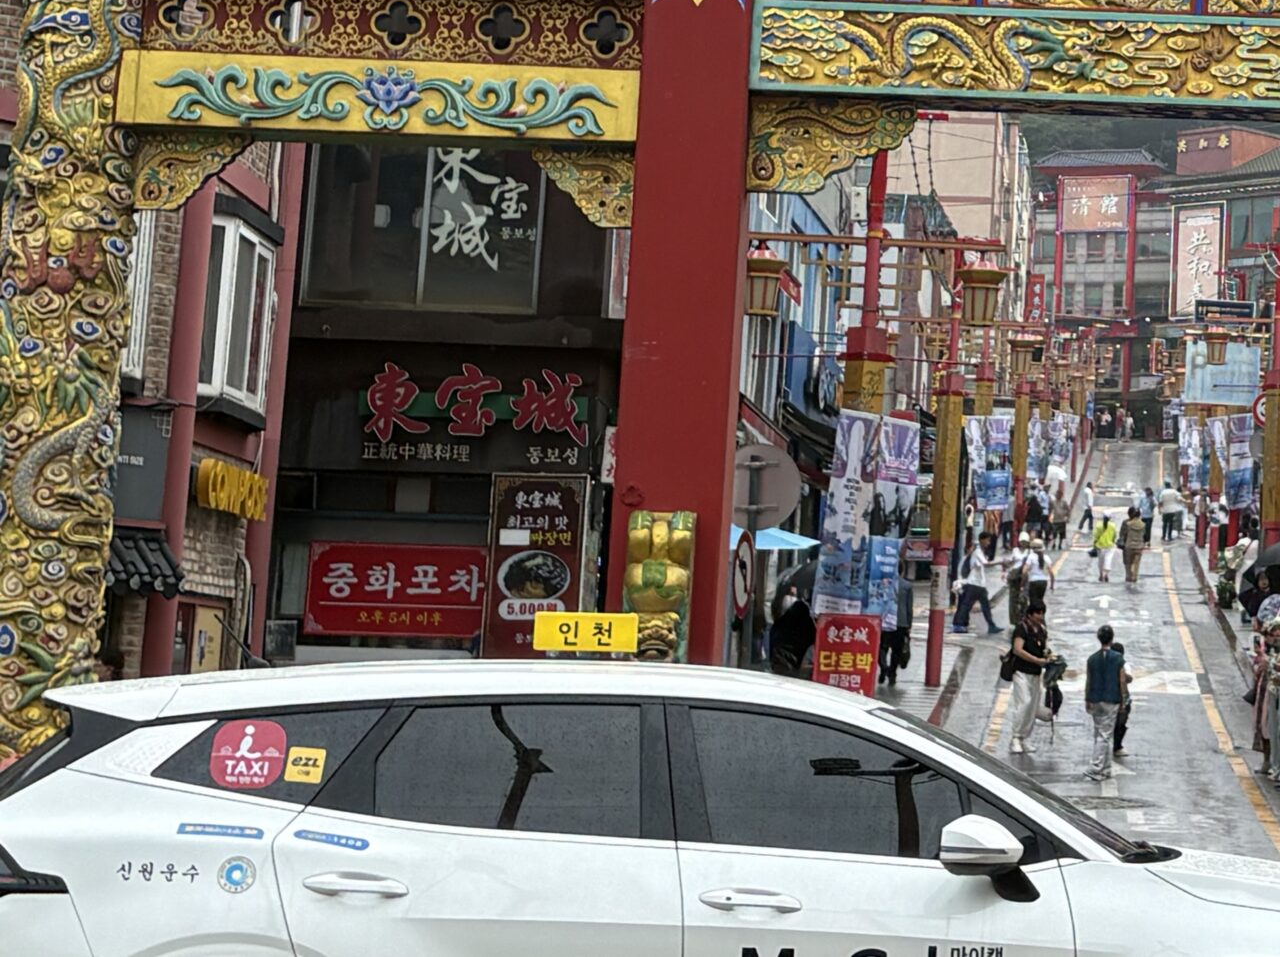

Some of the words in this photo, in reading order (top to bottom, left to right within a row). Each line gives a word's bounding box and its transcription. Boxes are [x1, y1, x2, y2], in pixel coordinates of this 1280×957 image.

[526, 447, 578, 465] 동보성
[555, 515, 569, 530] 맛
[322, 562, 485, 602] 중화포차
[357, 611, 384, 626] 오후
[388, 612, 410, 626] 5시
[416, 612, 443, 627] 이후
[559, 620, 613, 646] 인천
[820, 651, 873, 673] 단호박
[225, 760, 269, 776] TAXI
[117, 861, 199, 883] 신원운수
